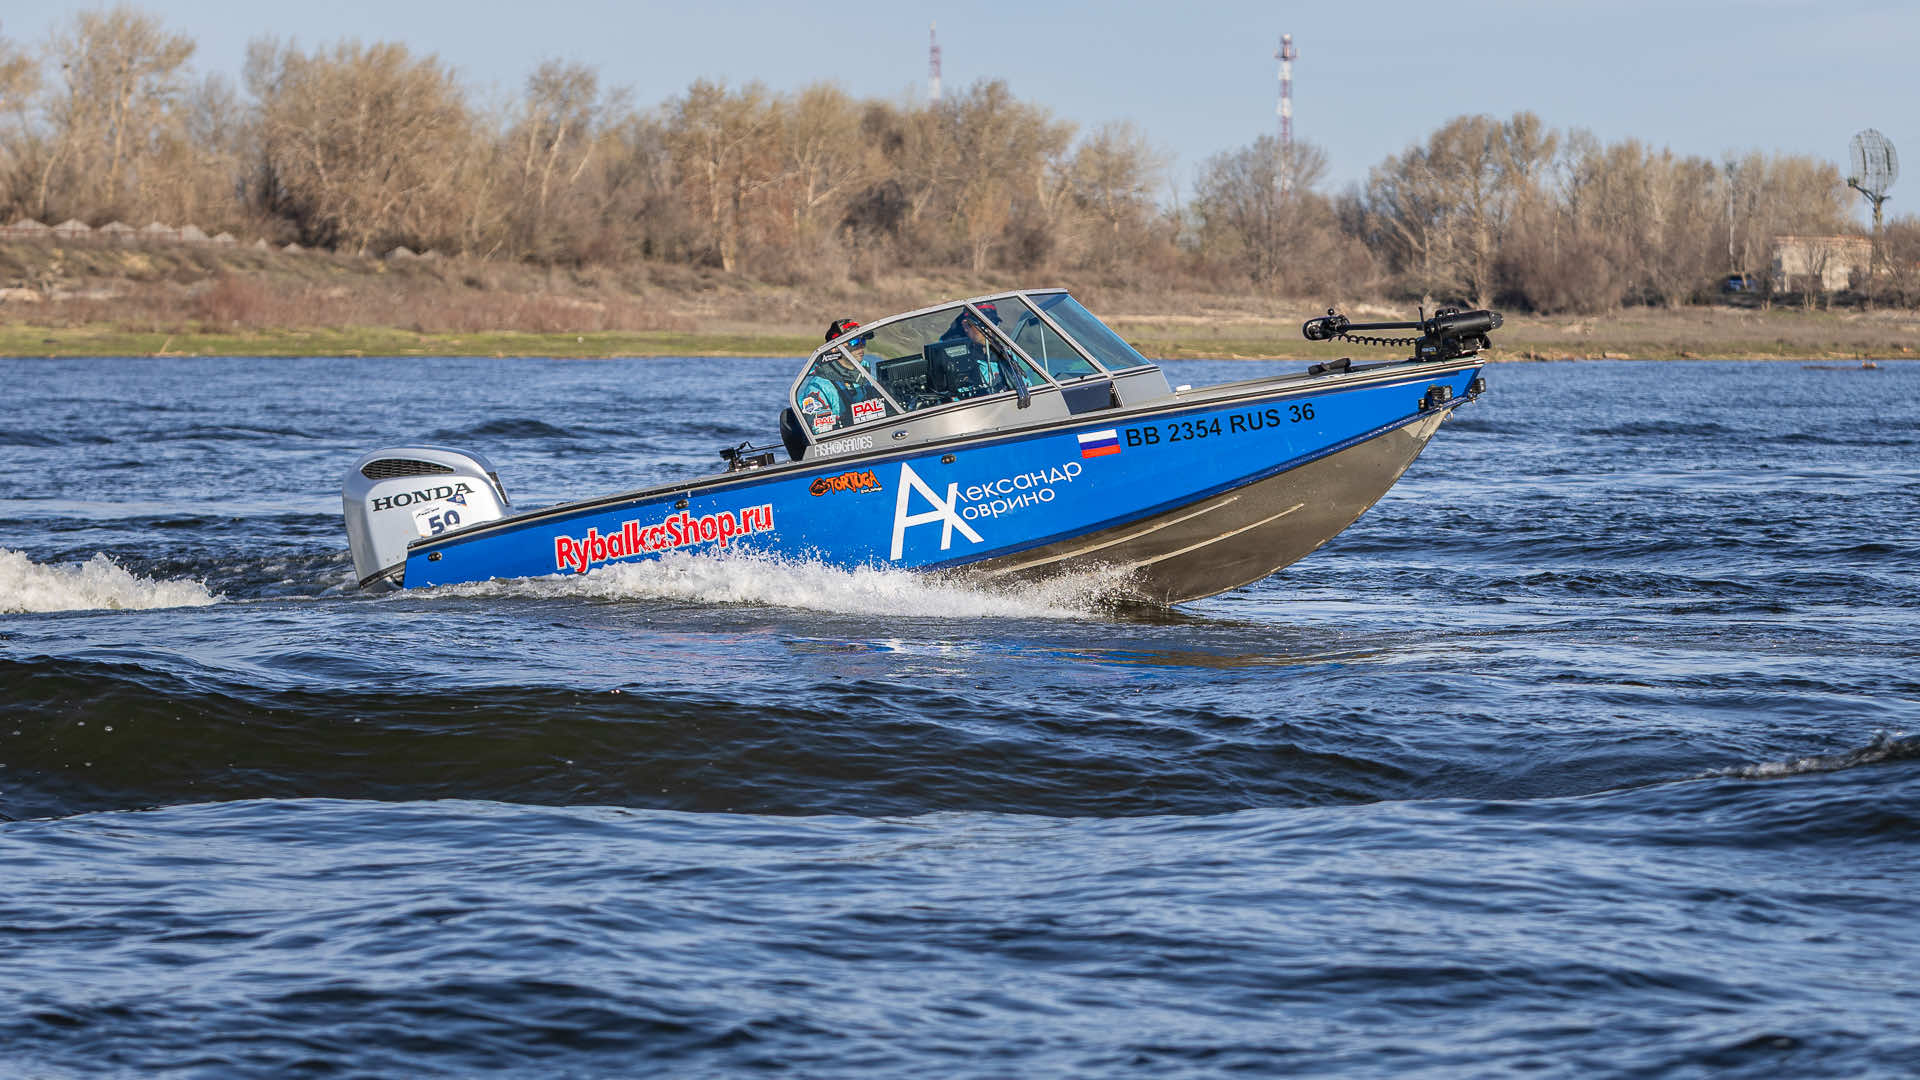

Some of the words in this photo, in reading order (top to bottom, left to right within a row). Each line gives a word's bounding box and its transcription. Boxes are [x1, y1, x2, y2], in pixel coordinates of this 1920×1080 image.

[853, 401, 883, 416] PAL
[1125, 426, 1160, 447] BB
[1167, 417, 1222, 443] 2354
[1230, 409, 1281, 434] RUS
[1288, 403, 1315, 423] 36
[825, 469, 882, 495] TORTUGA
[371, 482, 476, 512] HONDA
[428, 510, 461, 535] 50
[554, 504, 775, 573] RybalkaShop.ru
